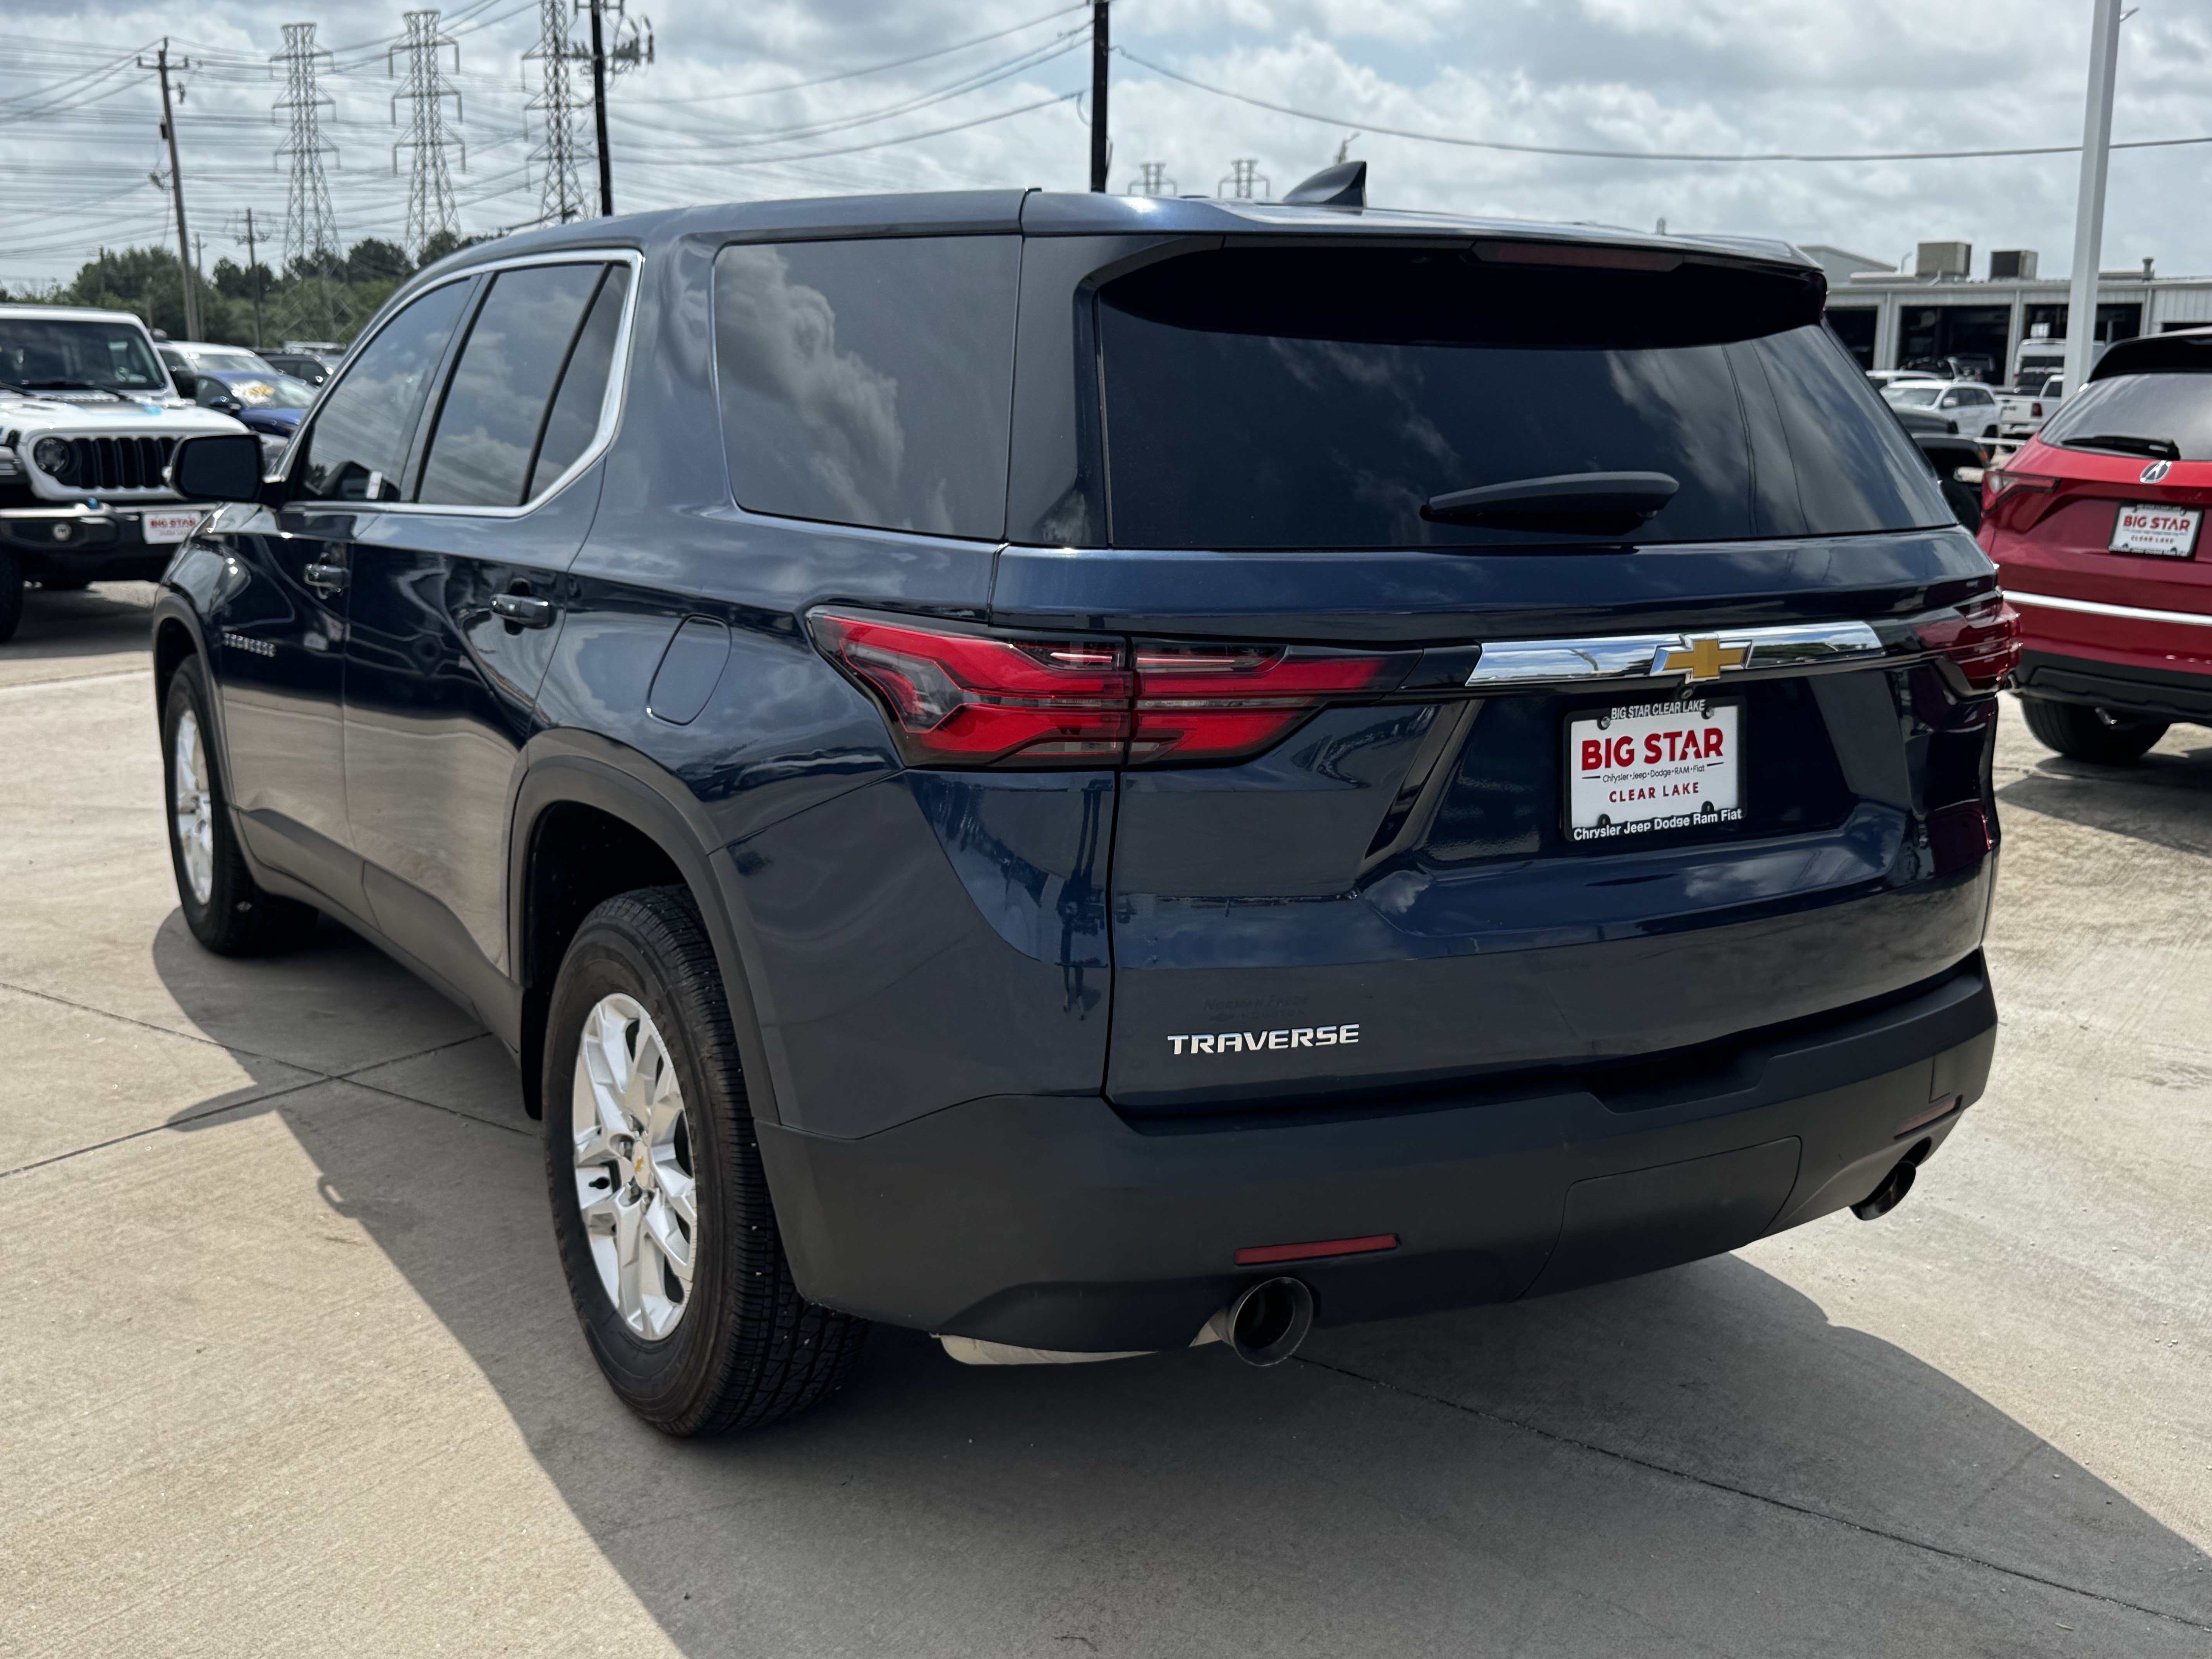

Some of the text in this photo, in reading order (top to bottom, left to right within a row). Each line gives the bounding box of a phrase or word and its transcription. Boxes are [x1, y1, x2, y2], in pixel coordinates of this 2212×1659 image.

[2123, 515, 2190, 531] BIG STAR
[1611, 699, 1706, 720] BIG STAR CLEAR LAKE
[1581, 728, 1724, 771] BIG STAR
[1609, 782, 1699, 803] CLEAR LAKE
[1573, 808, 1742, 841] Chrysler Jeep Dodge Ram Fiat
[1167, 1024, 1359, 1054] TRAVERSE
